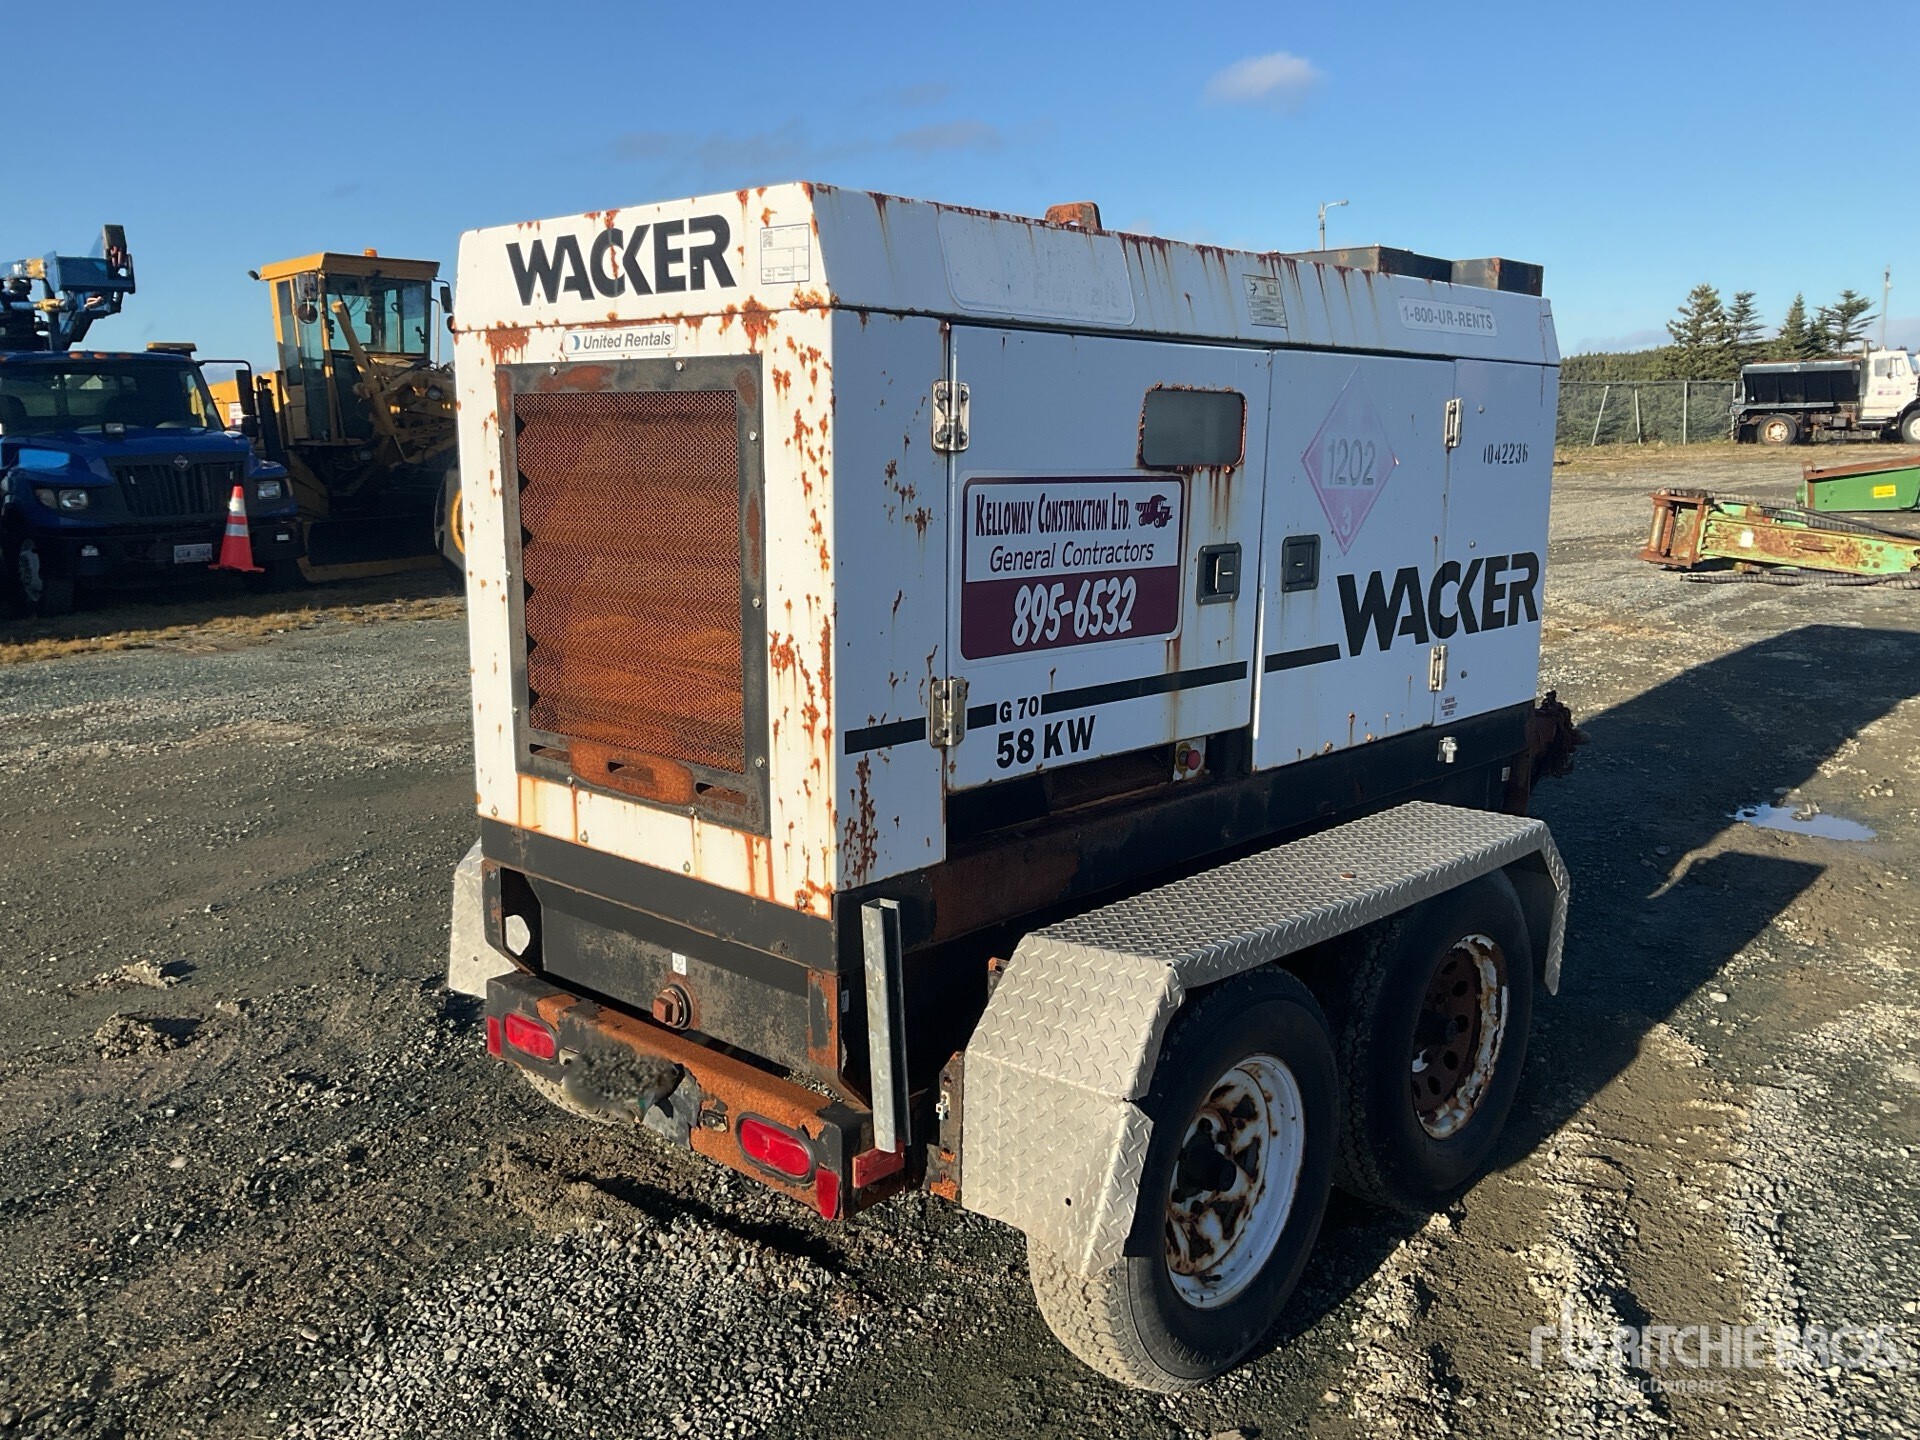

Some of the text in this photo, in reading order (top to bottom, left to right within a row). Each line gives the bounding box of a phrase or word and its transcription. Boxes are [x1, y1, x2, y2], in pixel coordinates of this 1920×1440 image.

[506, 213, 737, 306] WACKER
[1402, 304, 1493, 330] 1-800-UR-RENTS
[583, 330, 671, 350] United Rentals
[1327, 438, 1376, 487] 1202
[1483, 442, 1529, 465] 1042236
[975, 491, 1131, 537] KELLOWAY CONSTRUCTION LTD.
[1340, 506, 1353, 536] 3
[989, 538, 1155, 573] General Contractors
[1011, 575, 1137, 647] 895-6532
[1336, 551, 1540, 658] WACKER
[999, 694, 1039, 724] G 70
[996, 714, 1096, 769] 58 KW
